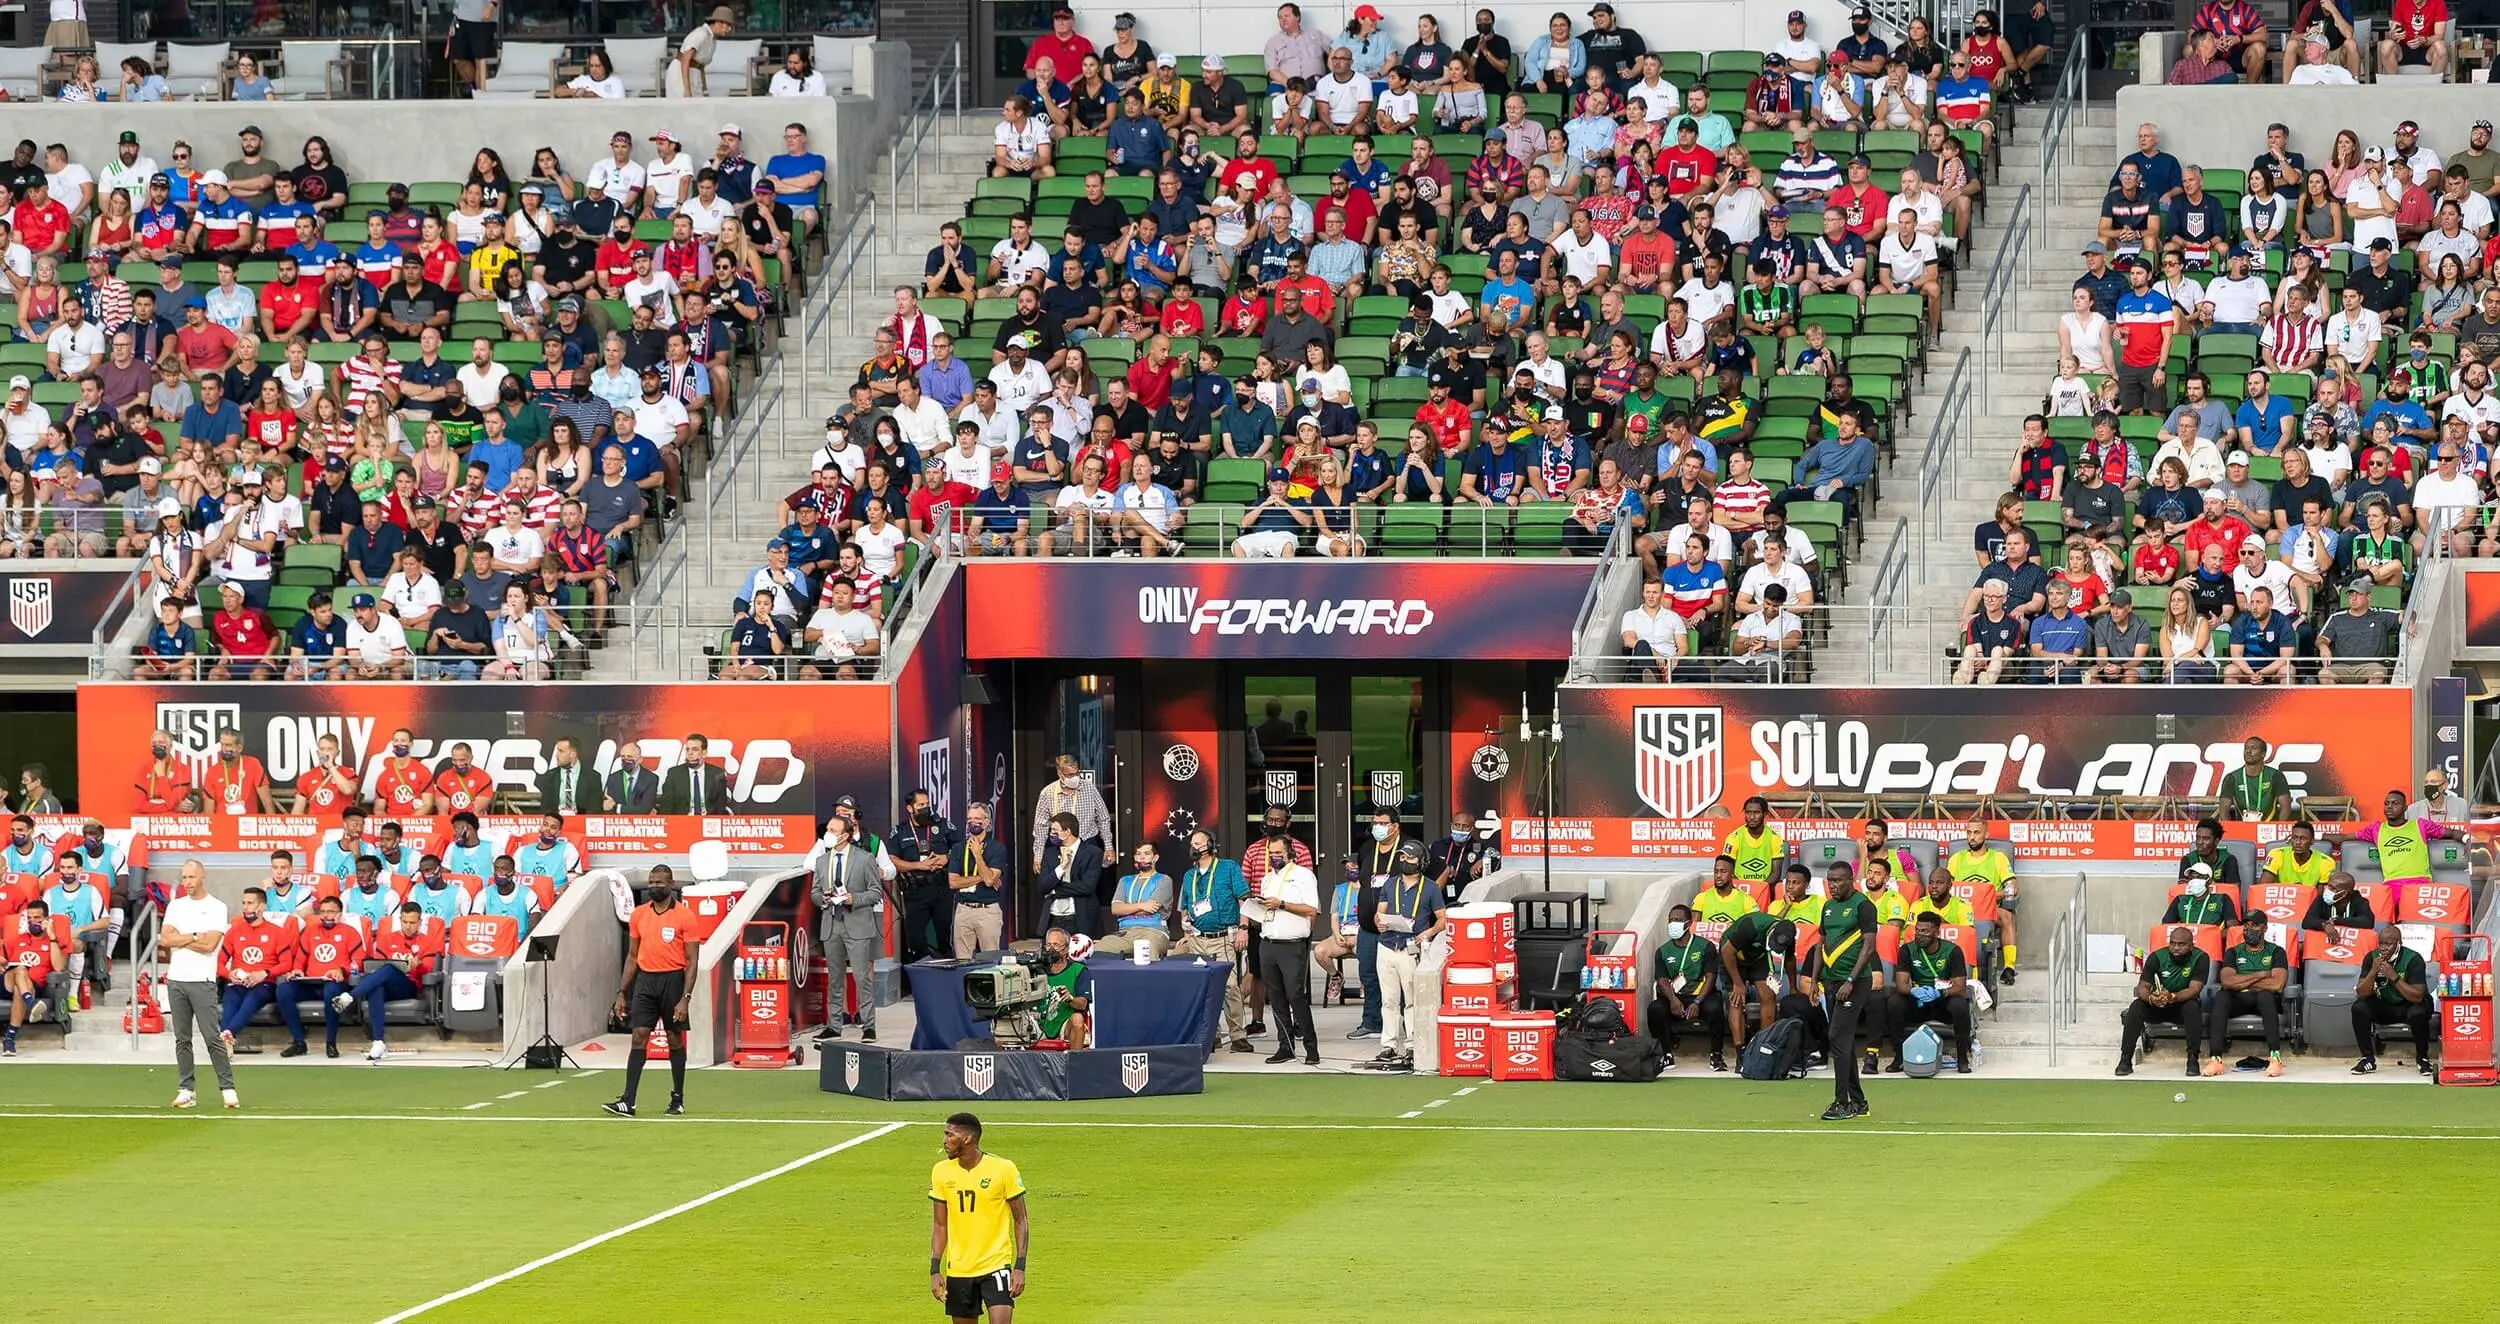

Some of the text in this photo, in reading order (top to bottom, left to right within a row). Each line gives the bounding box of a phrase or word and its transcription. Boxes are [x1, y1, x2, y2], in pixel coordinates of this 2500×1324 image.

[484, 186, 499, 200] SA
[2188, 215, 2204, 224] USA
[1637, 253, 1657, 266] USA
[1753, 309, 1780, 321] YETI
[1013, 386, 1025, 398] 10
[2059, 390, 2078, 399] NIKE
[263, 422, 281, 434] USA
[931, 501, 950, 514] USA
[13, 582, 49, 603] USA
[2200, 590, 2216, 598] AIG
[1139, 587, 1434, 635] ONLY FORWARD
[507, 634, 517, 648] 17
[163, 709, 234, 753] USA
[1641, 713, 1715, 758] USA
[1750, 720, 1870, 788] SOLO
[922, 747, 948, 813] USA
[1269, 773, 1295, 789] USA
[1374, 773, 1401, 789] USA
[178, 816, 213, 825] HEALTHY.
[285, 817, 319, 825] HEALTHY.
[517, 817, 543, 825] HEALT
[1531, 820, 1558, 828] CLEN.
[151, 824, 213, 837] HYDRATION.
[258, 825, 317, 837] HYDRATION
[606, 825, 668, 837] HYDRATION.
[723, 825, 785, 837] HYDRATION.
[2030, 823, 2056, 831] CLEAN.
[1531, 827, 1595, 840] HYRATION.
[1651, 828, 1715, 841] HYDRATION.
[1787, 829, 1851, 841] HYDRATION.
[1908, 829, 1968, 841] HYDRATION
[2030, 831, 2095, 843] HYDRATION.
[2155, 831, 2197, 843] HYDRAT
[238, 839, 302, 850] BIOSTEEL
[587, 840, 650, 851] BIOSTEEL
[725, 840, 767, 851] STEEL
[1631, 844, 1697, 854] BIOSTEEL
[2133, 847, 2190, 857] BIOSTEE
[2388, 847, 2412, 857] umbro
[2265, 886, 2297, 898] BIO
[2418, 886, 2450, 898] BIO
[2265, 898, 2296, 906] STEEL
[2418, 898, 2448, 906] STEEL
[467, 921, 497, 935] BIO
[1696, 921, 1727, 932] BIO
[466, 934, 496, 942] STEEL
[751, 989, 778, 1001] BIO
[2453, 1004, 2481, 1017] BIO
[1454, 1027, 1485, 1041] BIO
[1507, 1031, 1538, 1044] BIO
[846, 1052, 858, 1069] USA
[966, 1057, 992, 1072] USA
[1123, 1055, 1147, 1071] USA
[957, 1189, 976, 1213] 17
[992, 1269, 1011, 1292] 17
